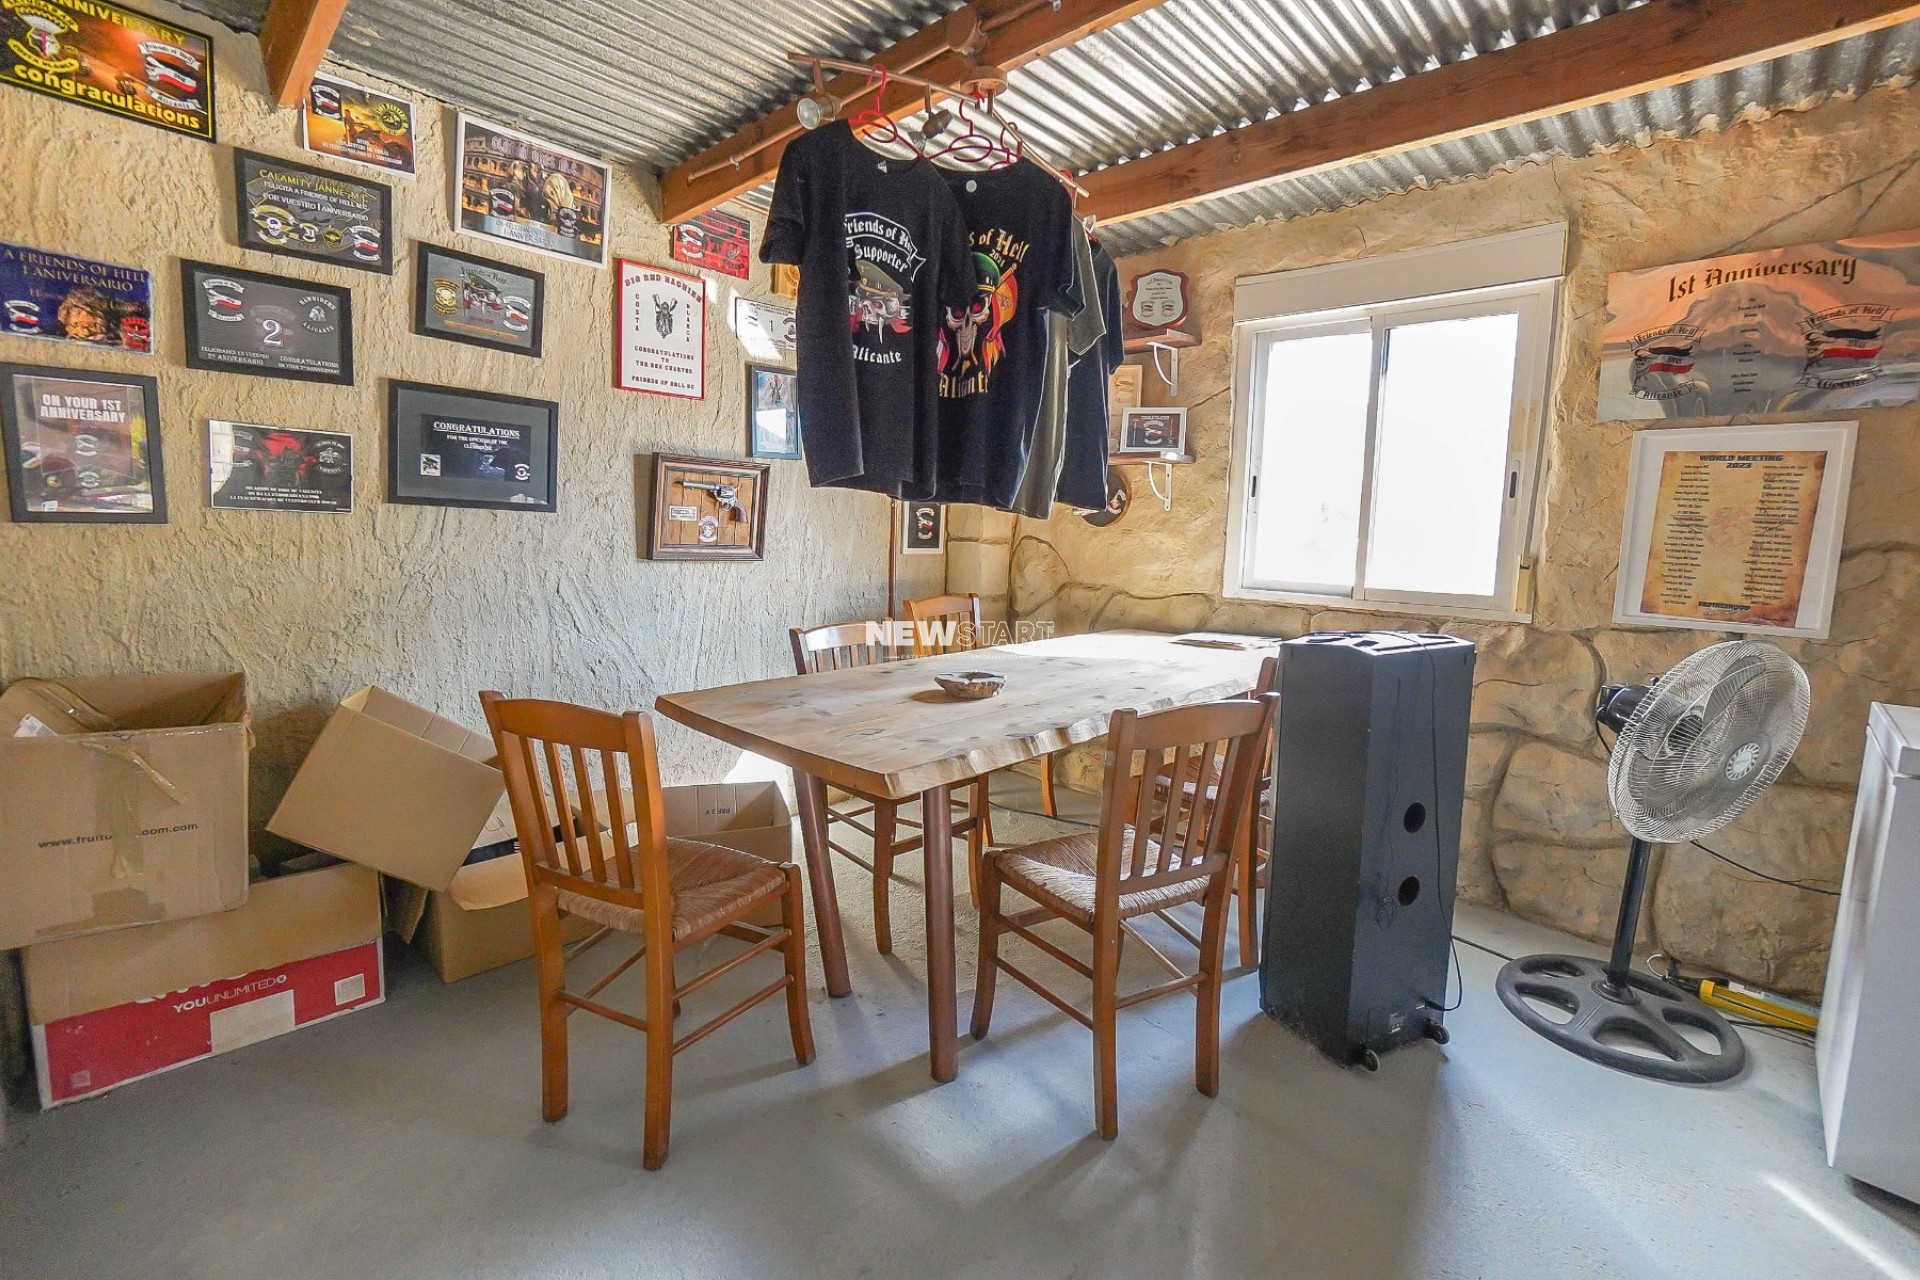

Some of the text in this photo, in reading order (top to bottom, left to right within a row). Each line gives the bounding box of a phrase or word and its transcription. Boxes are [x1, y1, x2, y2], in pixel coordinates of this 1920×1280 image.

[14, 64, 200, 129] congratulations
[259, 169, 311, 191] CALAMITY
[263, 192, 280, 202] POR
[281, 196, 317, 211] VUESTRO
[321, 206, 369, 221] ANIVERSARIO
[300, 189, 328, 201] FRIENDS
[329, 195, 337, 203] OF
[339, 197, 355, 208] HELL
[886, 227, 897, 240] of
[979, 228, 995, 246] of
[996, 228, 1030, 263] Hell
[4, 249, 146, 283] A FRIENDS OF HELL
[854, 243, 908, 273] Supporter
[989, 249, 1006, 267] 2021
[32, 265, 133, 291] ANIVERSARIO
[1669, 258, 1858, 303] 1st Anniversary
[1848, 306, 1859, 314] of
[1862, 306, 1882, 315] Hell
[262, 319, 283, 345] 2
[1679, 326, 1695, 336] Hell
[217, 354, 264, 365] ANIVERSARIO
[280, 356, 339, 368] CONGRATULATIONS
[634, 345, 695, 361] CONGRATULATIONS
[635, 360, 648, 368] THE
[42, 394, 121, 411] ON YOUR 1ST
[40, 406, 127, 423] ANNIVERSARY
[433, 421, 520, 436] CONGRATULATIONS
